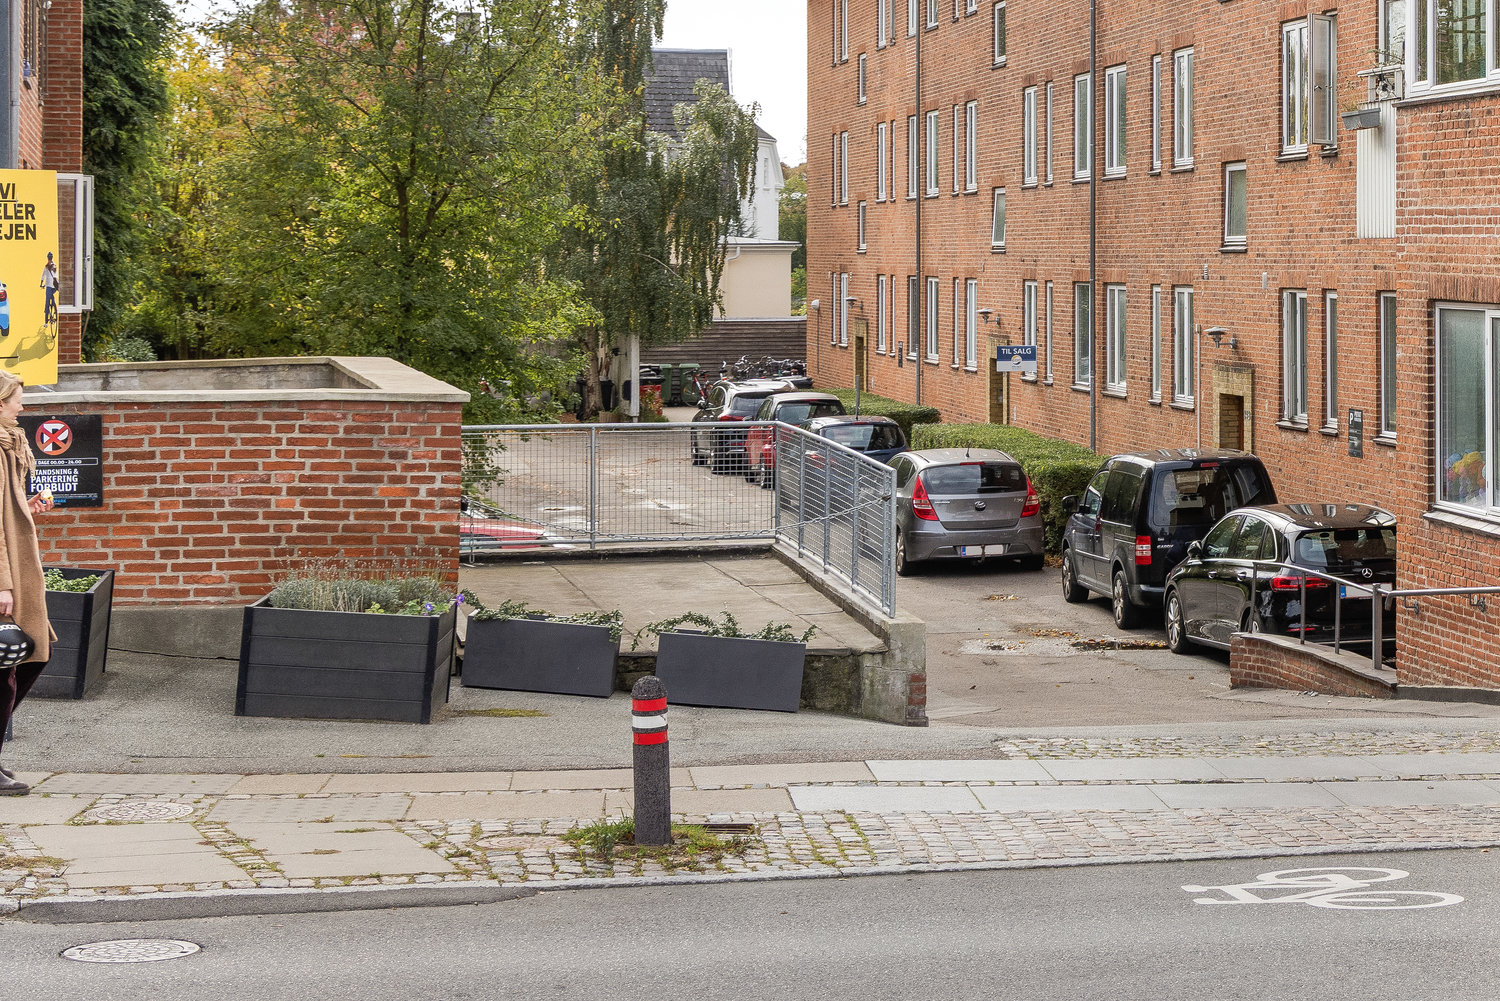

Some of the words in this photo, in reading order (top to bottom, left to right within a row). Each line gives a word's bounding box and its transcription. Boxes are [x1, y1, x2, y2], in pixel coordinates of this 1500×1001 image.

[0, 203, 36, 220] LER
[0, 223, 37, 240] JEN
[1012, 347, 1032, 355] SALG
[34, 468, 72, 476] TANDSNING
[30, 475, 78, 484] PARKERING
[30, 482, 78, 493] FORBUDT
